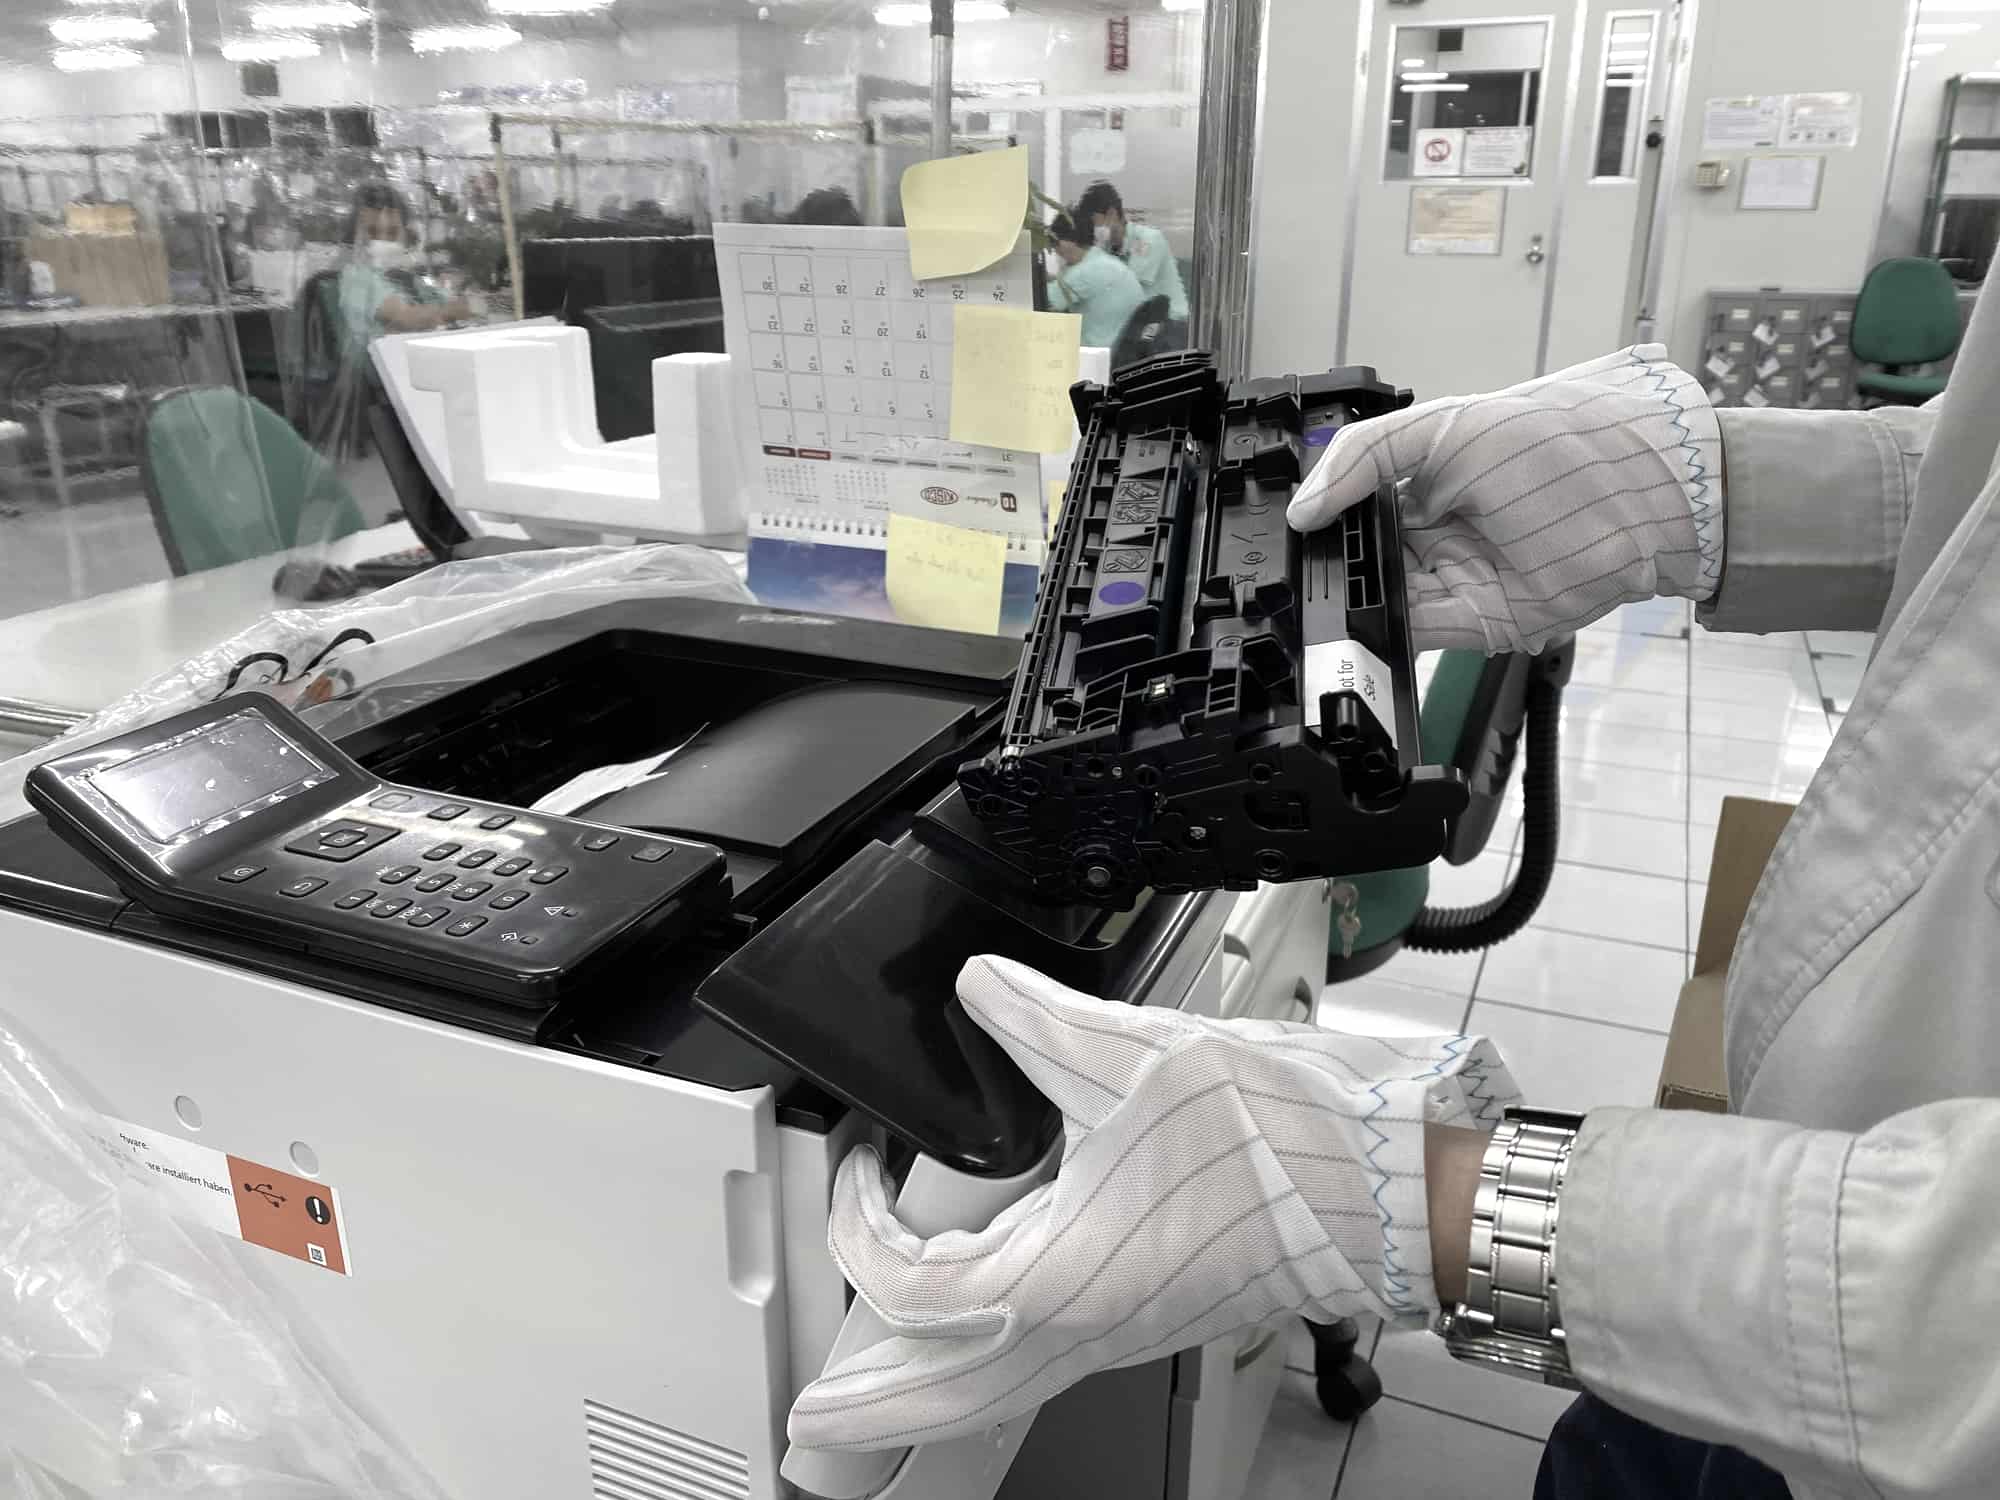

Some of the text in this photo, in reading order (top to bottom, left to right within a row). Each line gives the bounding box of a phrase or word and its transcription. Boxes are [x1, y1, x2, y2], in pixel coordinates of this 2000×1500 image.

[835, 284, 848, 295] 28
[875, 286, 886, 296] 27
[912, 287, 925, 298] 26
[952, 289, 964, 300] 25
[993, 291, 1005, 301] 24
[841, 325, 852, 335] 21
[876, 327, 888, 337] 20
[881, 367, 892, 377] 13
[919, 369, 930, 379] 12
[888, 406, 896, 415] 6
[926, 409, 934, 418] 5
[1001, 495, 1015, 510] 10
[1337, 659, 1354, 688] ot for
[385, 903, 398, 911] 4
[162, 1167, 202, 1187] installiert
[203, 1178, 233, 1197] haben.
